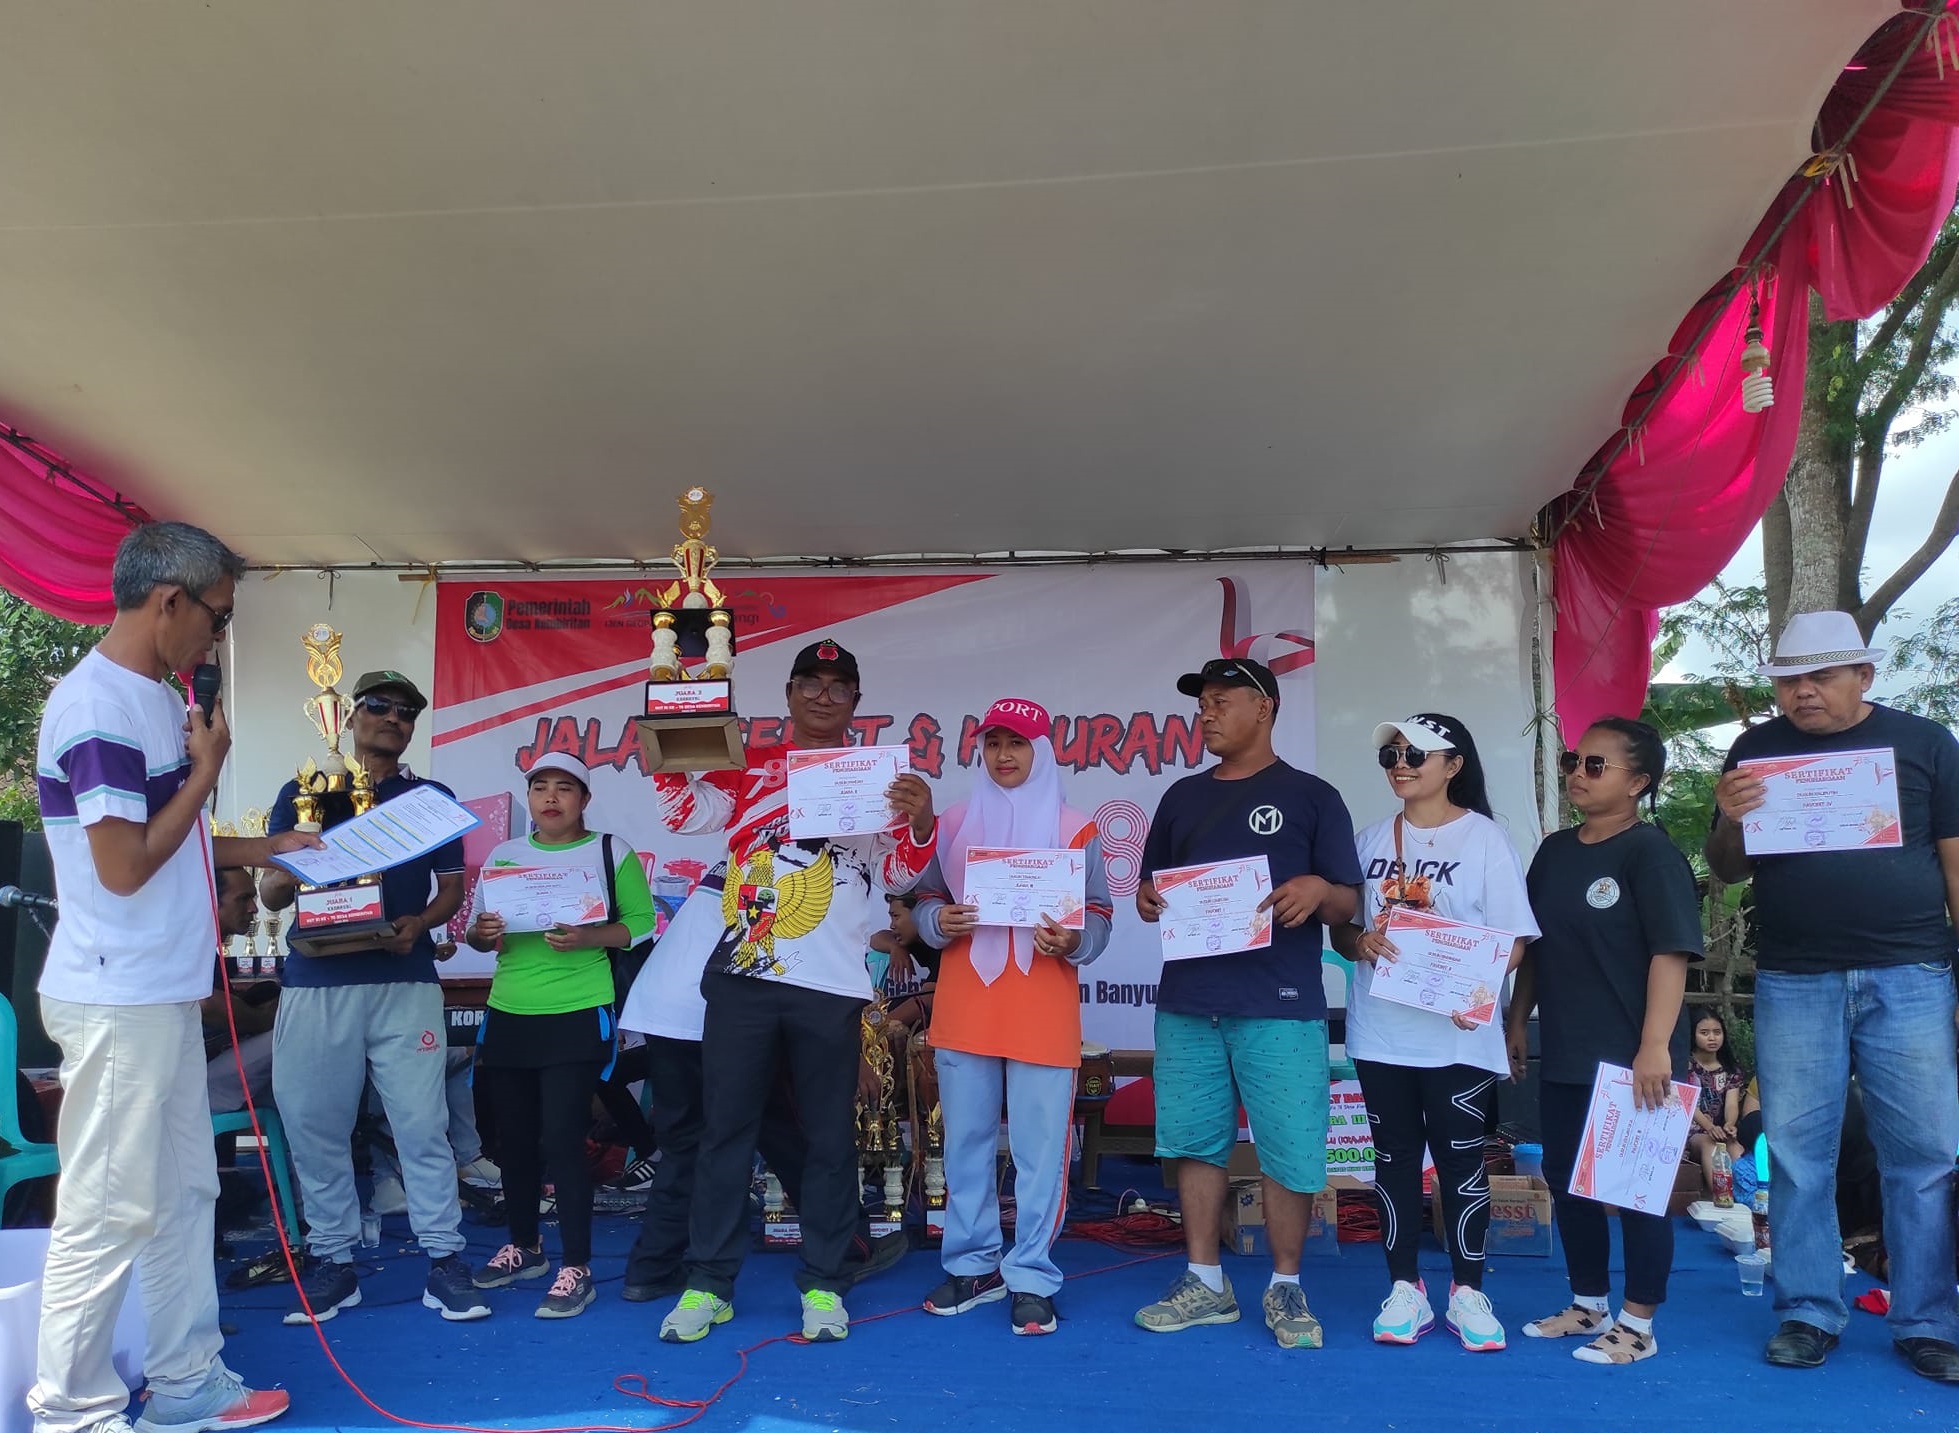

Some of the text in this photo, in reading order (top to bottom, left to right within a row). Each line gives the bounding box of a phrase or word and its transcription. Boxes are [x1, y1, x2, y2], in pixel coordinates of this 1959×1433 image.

[986, 701, 1043, 722] PORT
[515, 715, 650, 777] JALA
[824, 759, 878, 770] SERTIFIKAT
[1784, 767, 1853, 780] SERTIFIKAT
[1002, 858, 1055, 866] SERTIFIKAT
[1188, 874, 1239, 888] SERTIFIKAT
[1424, 929, 1480, 948] SERTIFIKAT
[1096, 981, 1159, 1007] Banyu
[451, 1010, 485, 1026] KOR
[1595, 1101, 1618, 1160] SERTIFIKAT
[1326, 1147, 1376, 1164] 500.0
